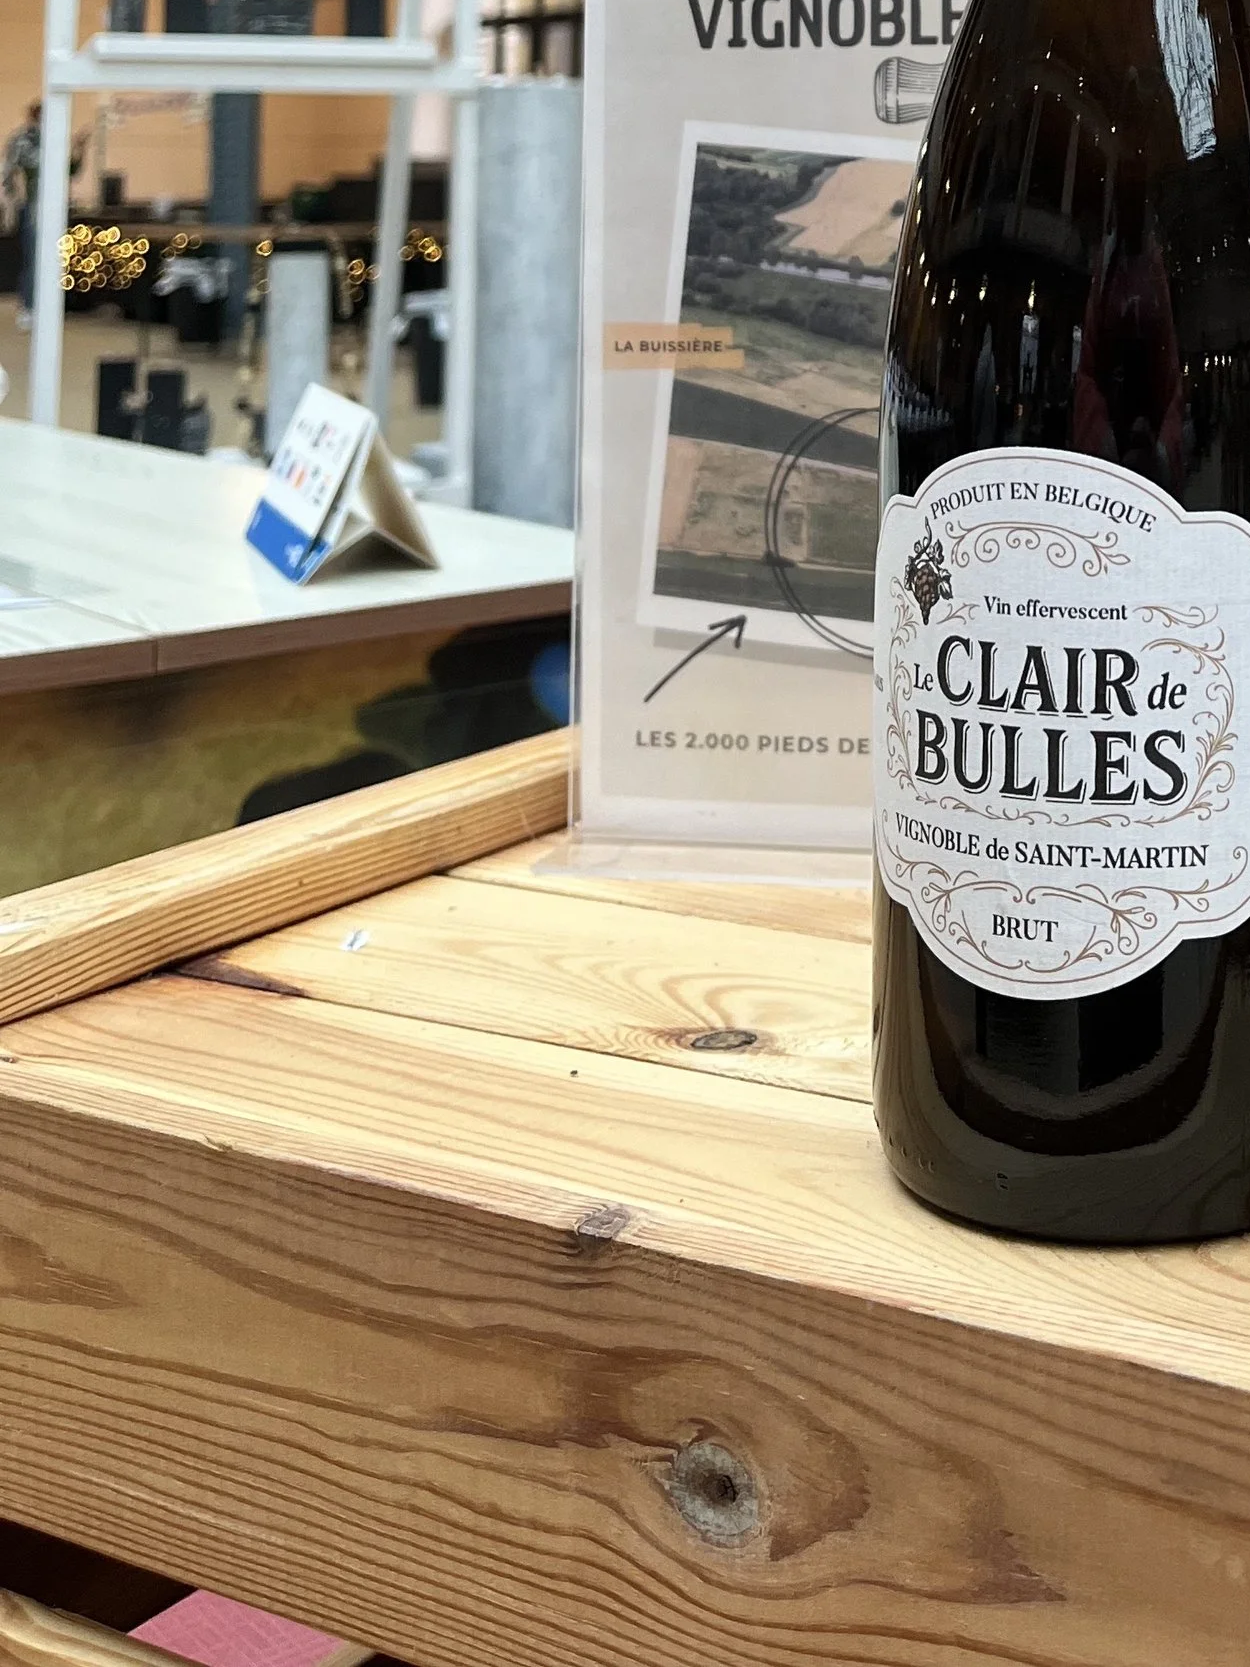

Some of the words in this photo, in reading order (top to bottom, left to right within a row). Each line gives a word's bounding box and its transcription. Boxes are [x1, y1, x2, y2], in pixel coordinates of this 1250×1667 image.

[614, 340, 634, 352] LA
[639, 337, 723, 353] BUISSIÈRE
[930, 482, 1006, 520] PRODUIT
[1011, 482, 1040, 501] EN
[1045, 485, 1157, 533] BELGIQUE
[983, 595, 1011, 616] Vin
[1015, 598, 1128, 621] effervescent
[913, 662, 934, 692] Le
[936, 634, 1141, 720] CLAIR
[1147, 671, 1187, 710] de
[636, 730, 677, 748] LES
[685, 732, 750, 751] 2.000
[758, 735, 830, 754] PIEDS
[839, 737, 871, 755] DE
[915, 708, 1187, 806] BULLES
[895, 811, 981, 857] VIGNOBLE
[985, 837, 1010, 861] de
[1014, 841, 1210, 869] SAINT-MARTIN
[991, 913, 1059, 943] BRUT
